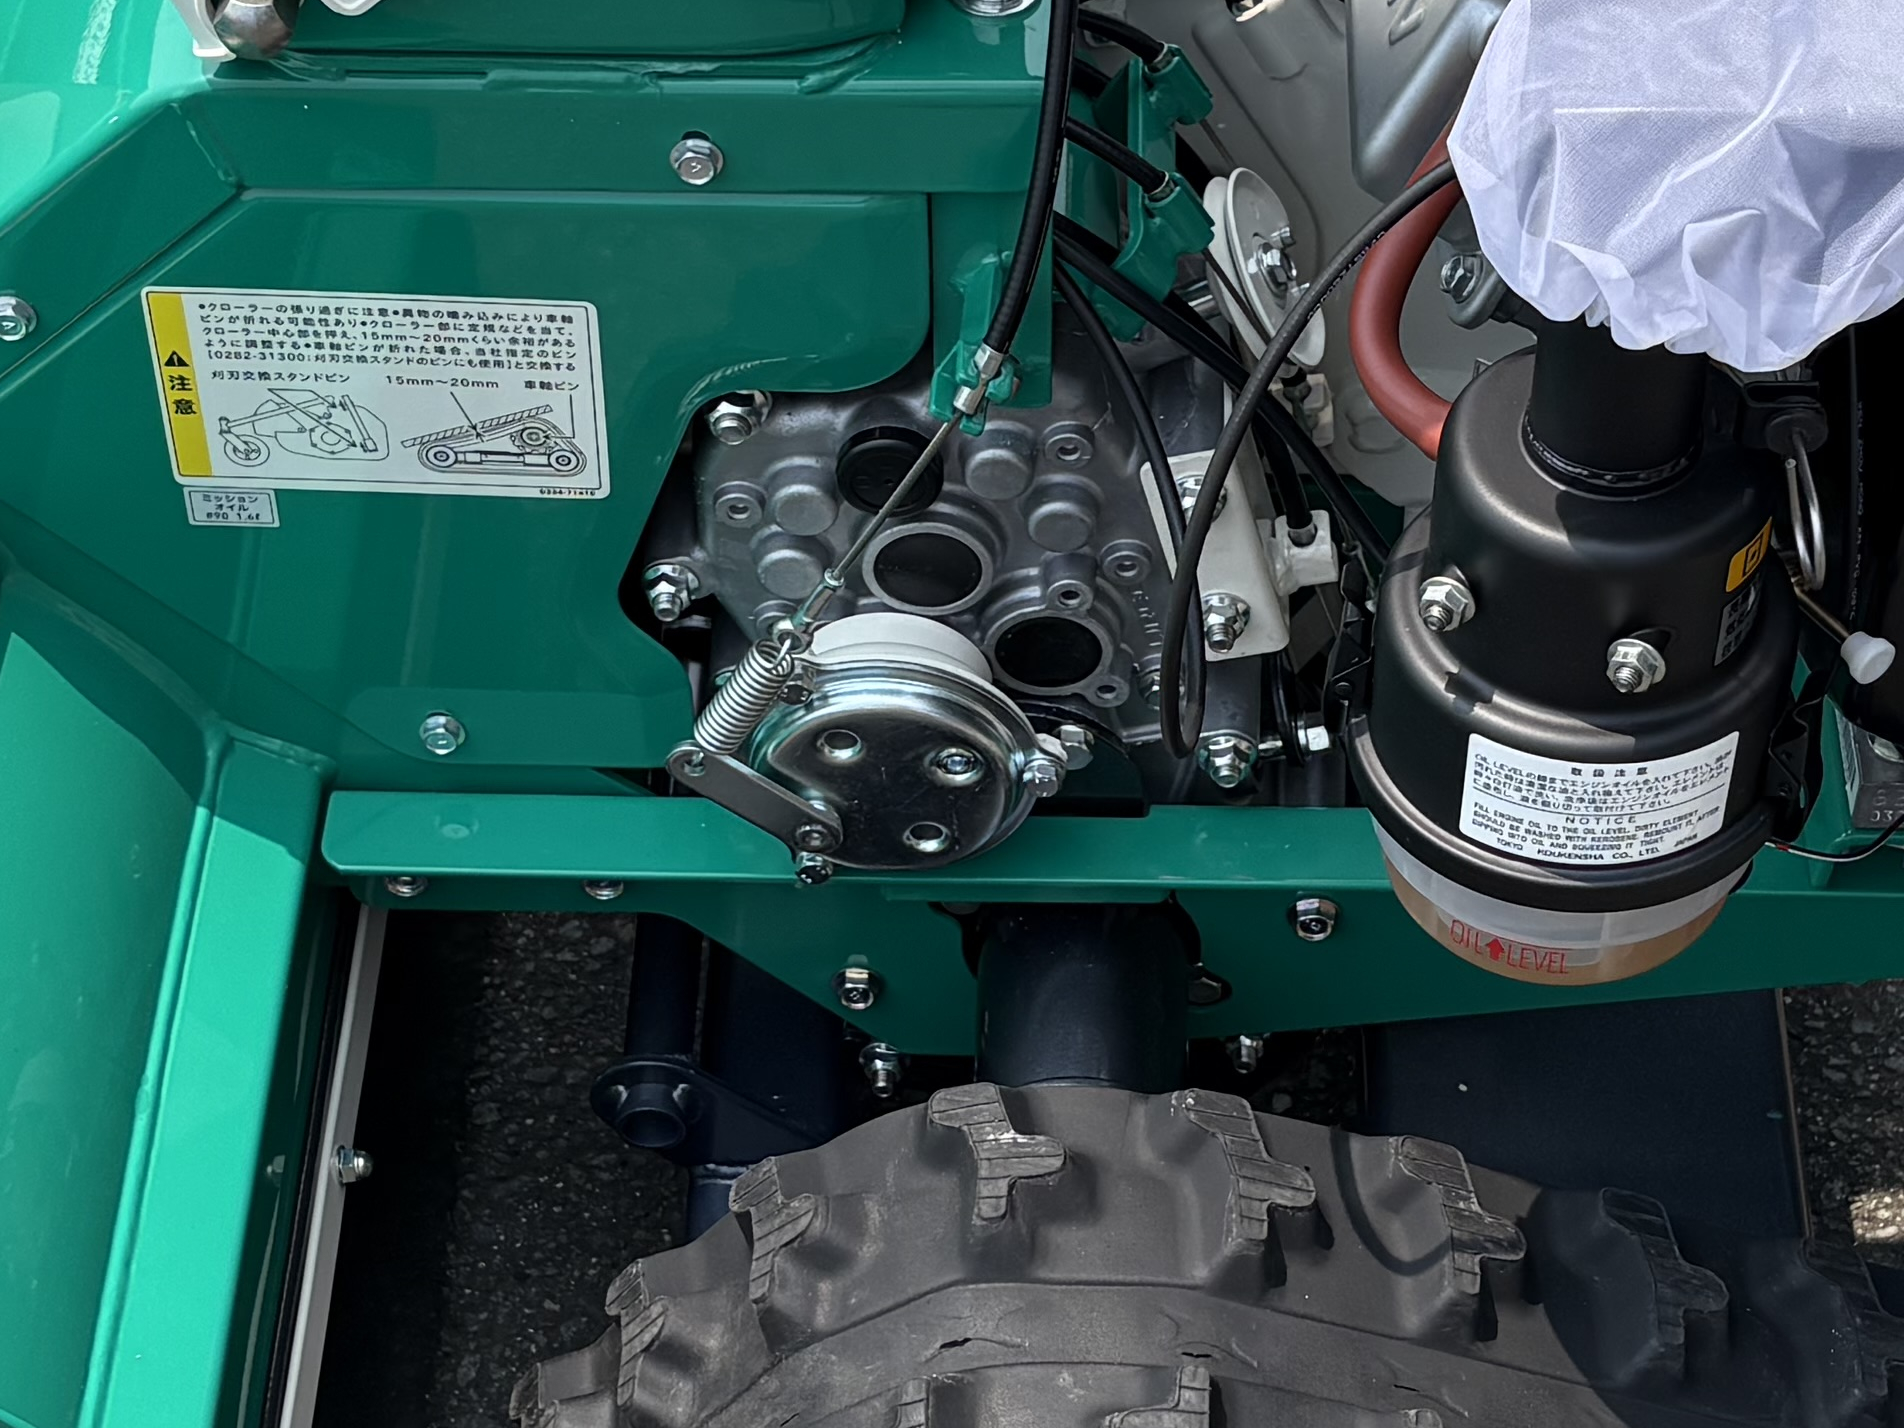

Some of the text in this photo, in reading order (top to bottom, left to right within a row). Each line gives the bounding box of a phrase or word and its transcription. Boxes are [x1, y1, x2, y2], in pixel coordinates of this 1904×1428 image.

[167, 374, 198, 416] 注意
[201, 493, 259, 504] ミッション
[213, 502, 249, 512] オイル
[1473, 801, 1490, 813] FILL
[1527, 820, 1541, 829] OIL
[1546, 823, 1558, 832] TO
[1561, 825, 1579, 834] THE
[1582, 826, 1597, 835] OIL
[1634, 821, 1660, 832] DIRTY
[1564, 815, 1636, 825] NOTICE
[1508, 823, 1520, 832] BE
[1523, 827, 1561, 840] WASHED
[1494, 836, 1524, 850] TOKYO
[1536, 847, 1604, 860] KOUKENSHA
[1530, 837, 1545, 846] OIL
[1549, 841, 1568, 849] AND
[1449, 919, 1569, 975] OIL LEVEL
